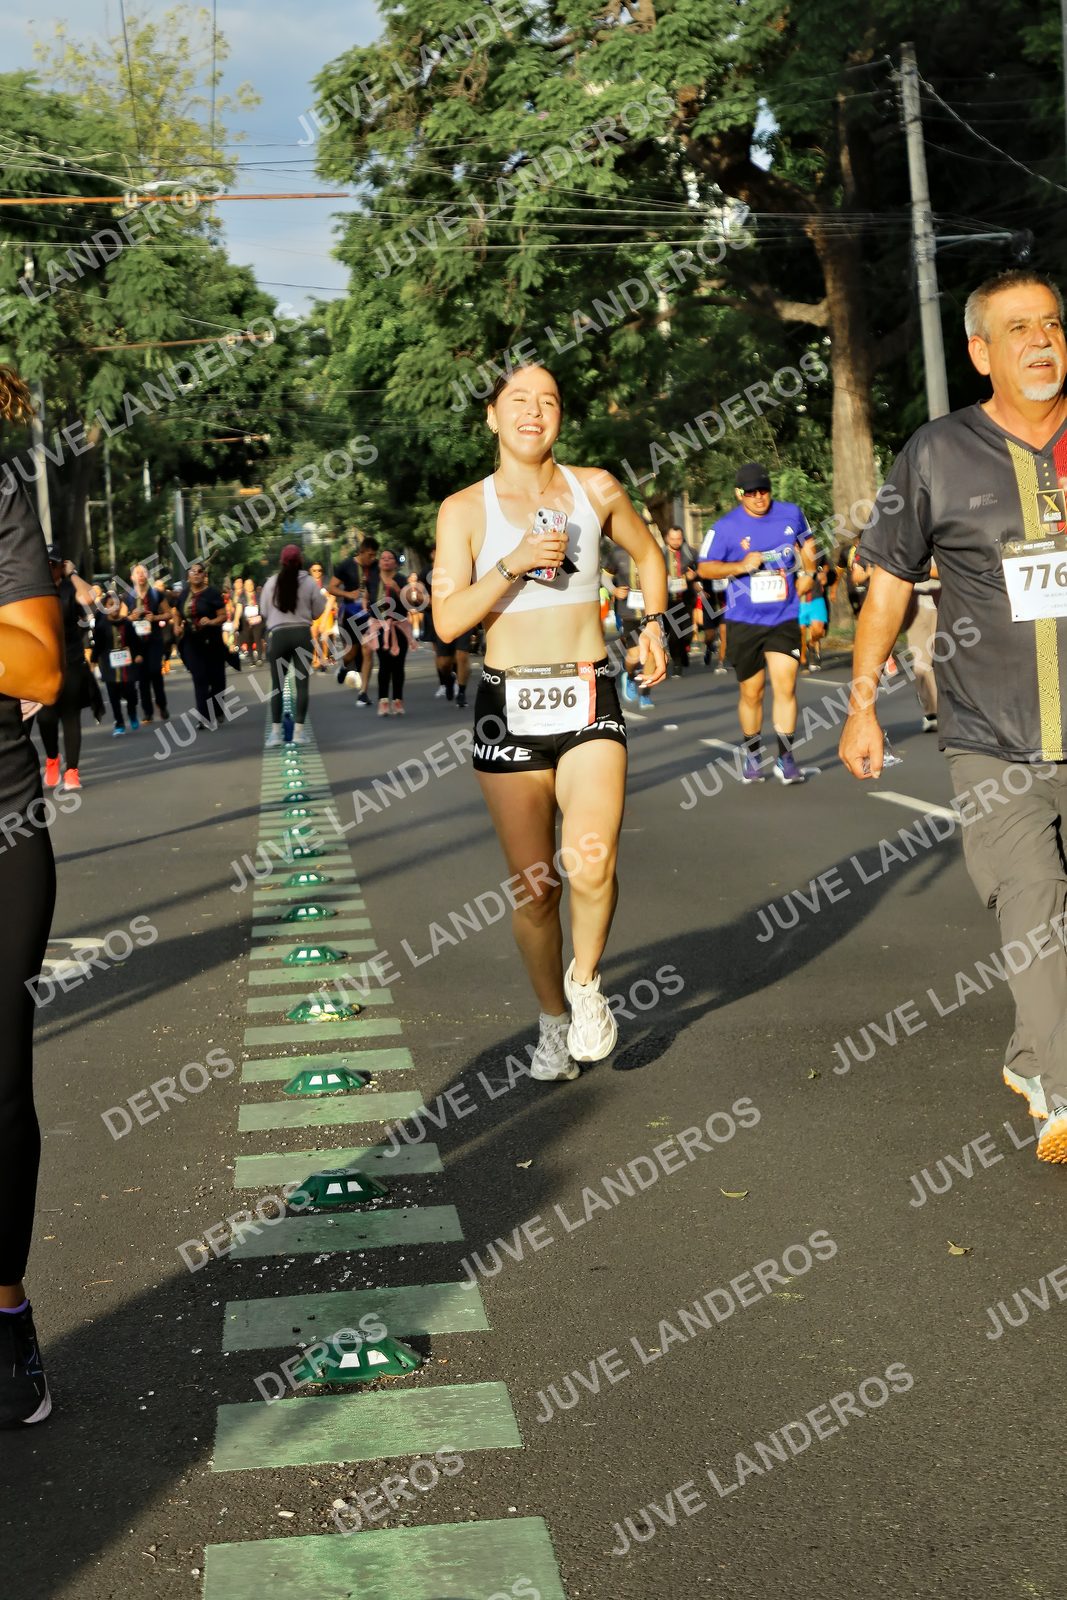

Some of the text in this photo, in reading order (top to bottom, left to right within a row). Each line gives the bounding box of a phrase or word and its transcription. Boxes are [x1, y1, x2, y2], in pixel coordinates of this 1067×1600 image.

[1019, 562, 1067, 592] 776
[518, 686, 577, 710] 8296
[474, 743, 532, 761] NIKE
